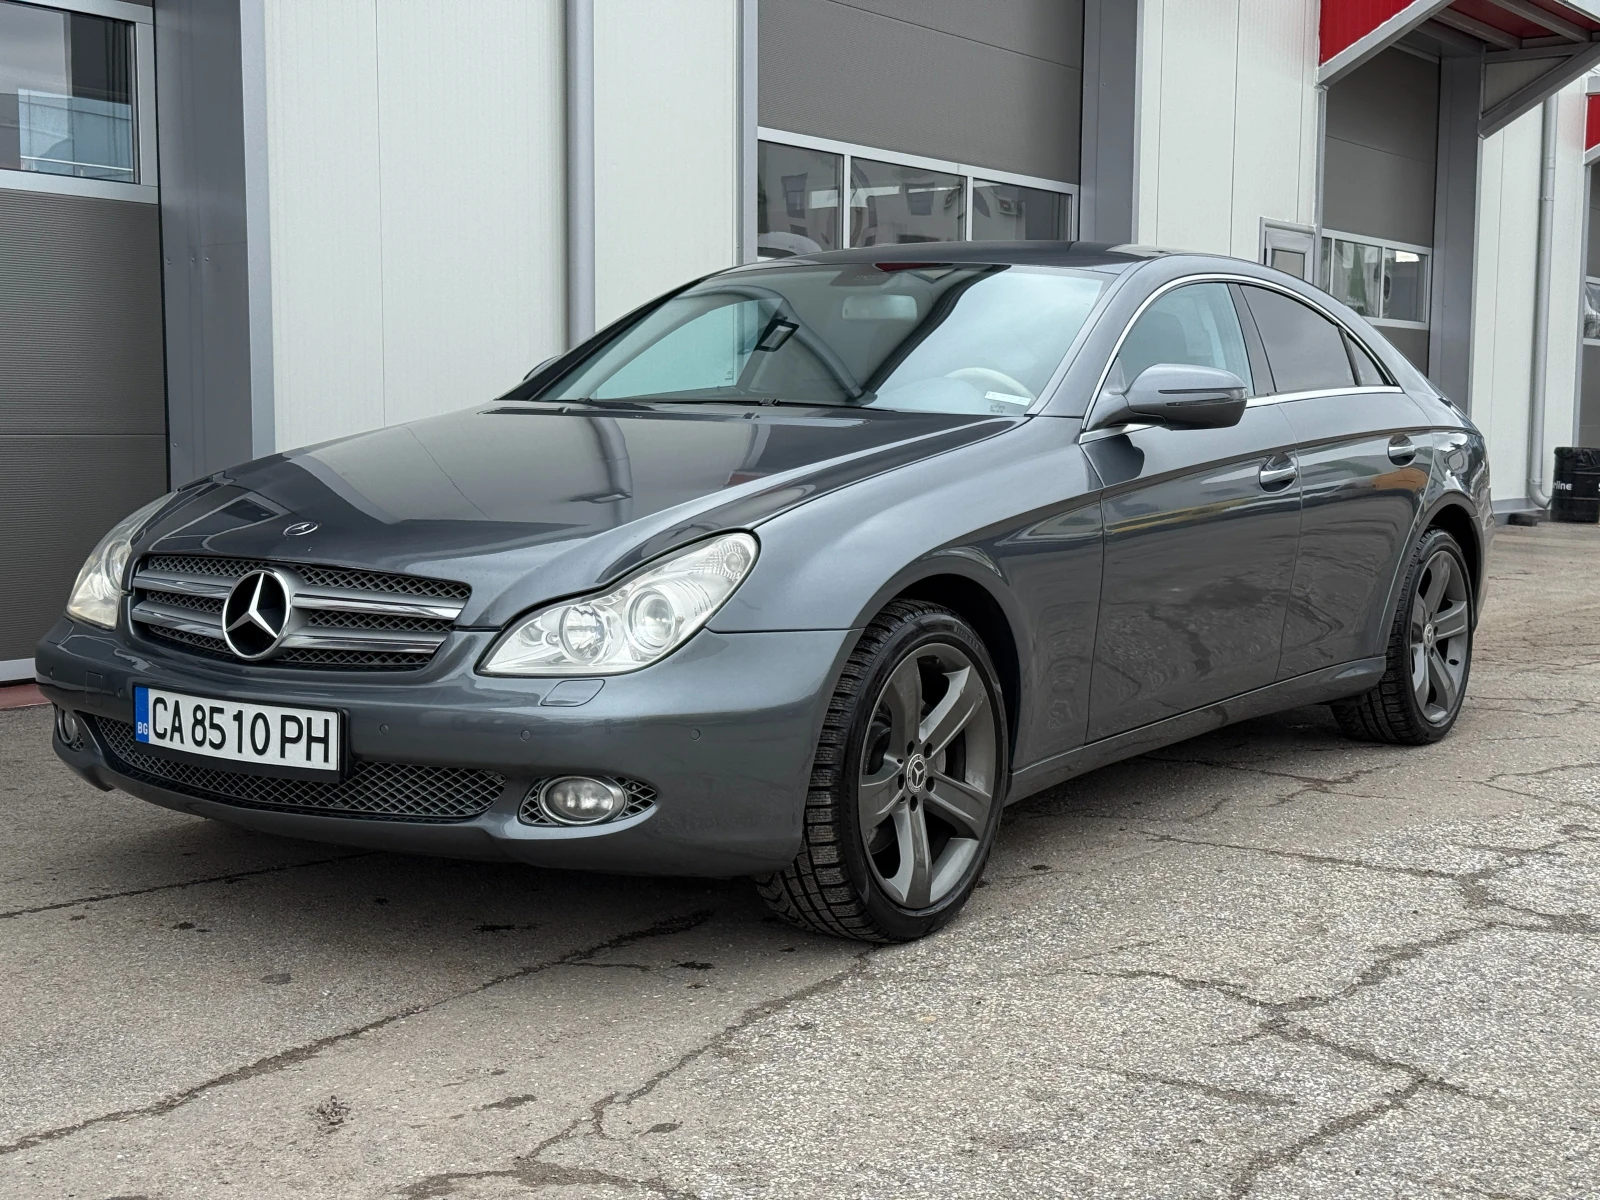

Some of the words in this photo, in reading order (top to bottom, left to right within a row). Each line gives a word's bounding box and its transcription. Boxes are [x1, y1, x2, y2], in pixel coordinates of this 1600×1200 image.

[137, 721, 148, 735] BG
[152, 696, 185, 745] CA
[191, 703, 271, 756] 8510
[279, 714, 330, 764] PH
